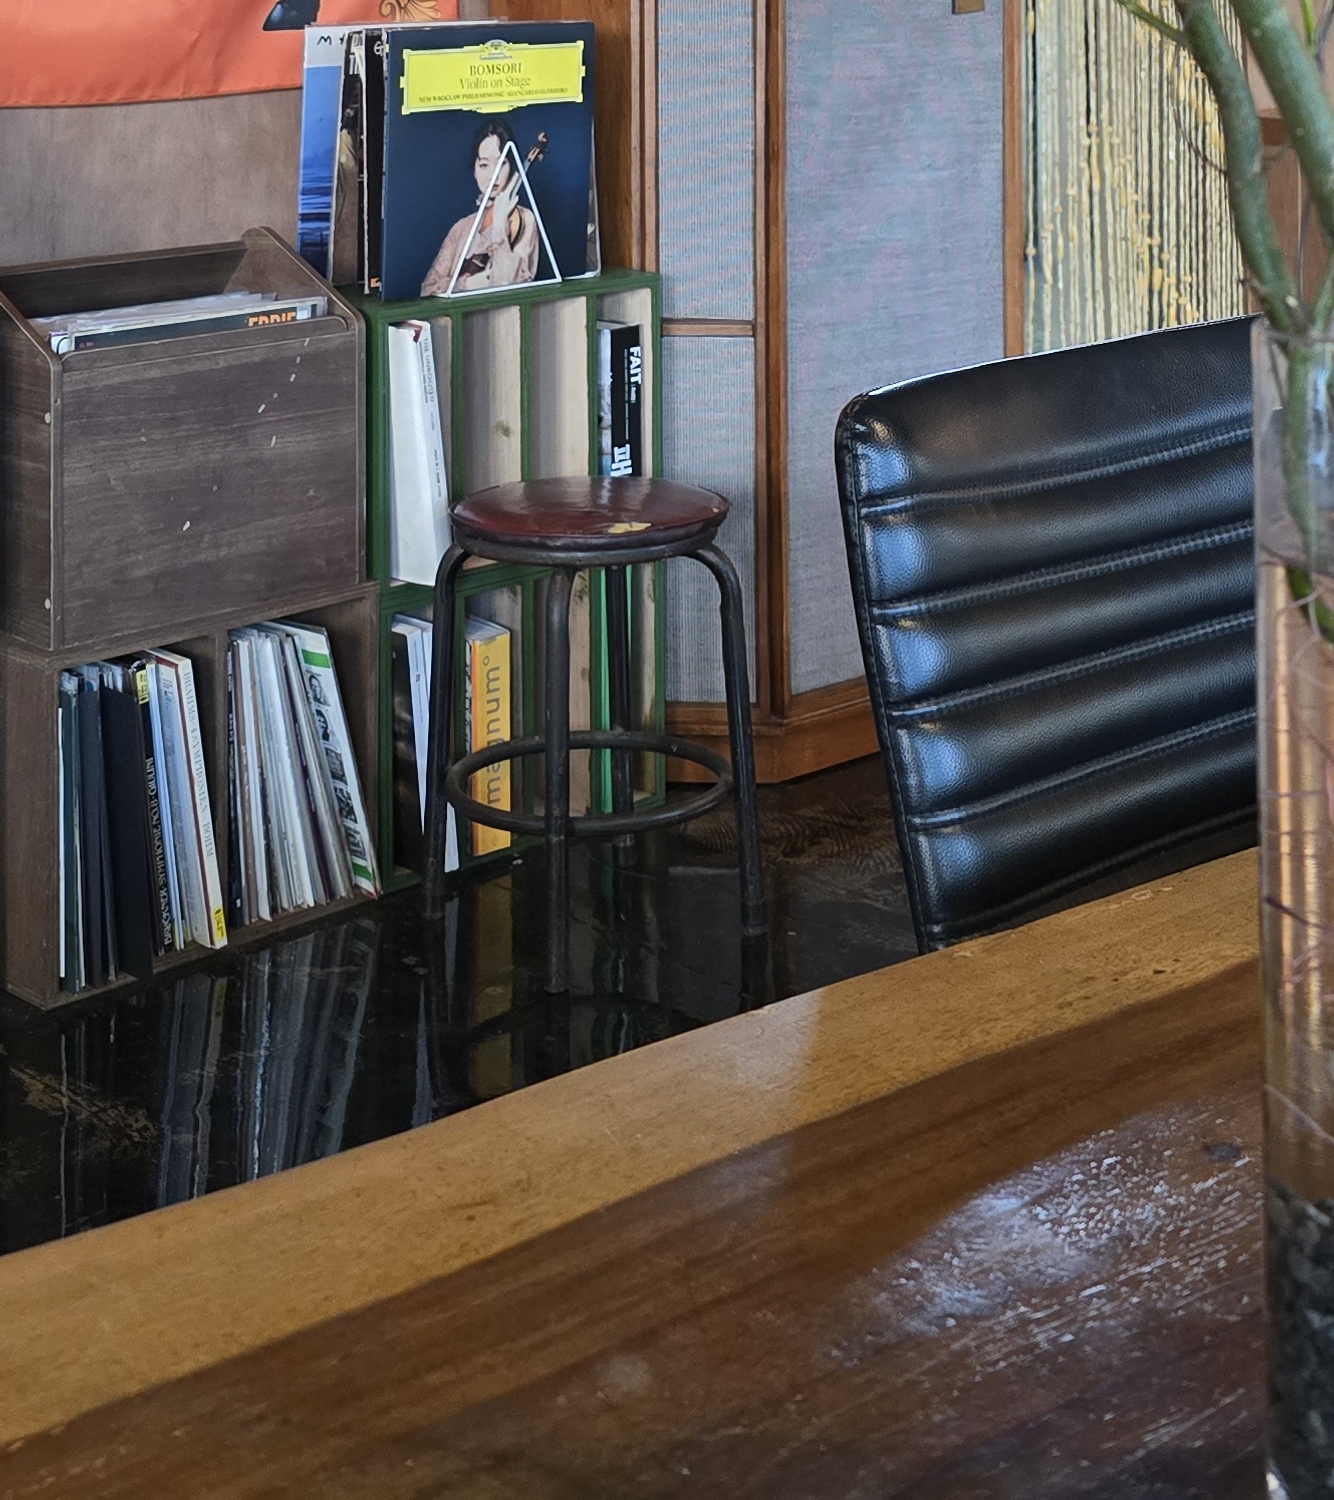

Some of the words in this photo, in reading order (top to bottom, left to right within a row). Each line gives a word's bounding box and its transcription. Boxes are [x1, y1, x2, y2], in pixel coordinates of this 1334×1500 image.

[469, 62, 522, 77] BOMSORI
[460, 77, 488, 90] Violin
[490, 79, 503, 88] on
[505, 75, 531, 90] Stage
[629, 346, 642, 384] FAIT
